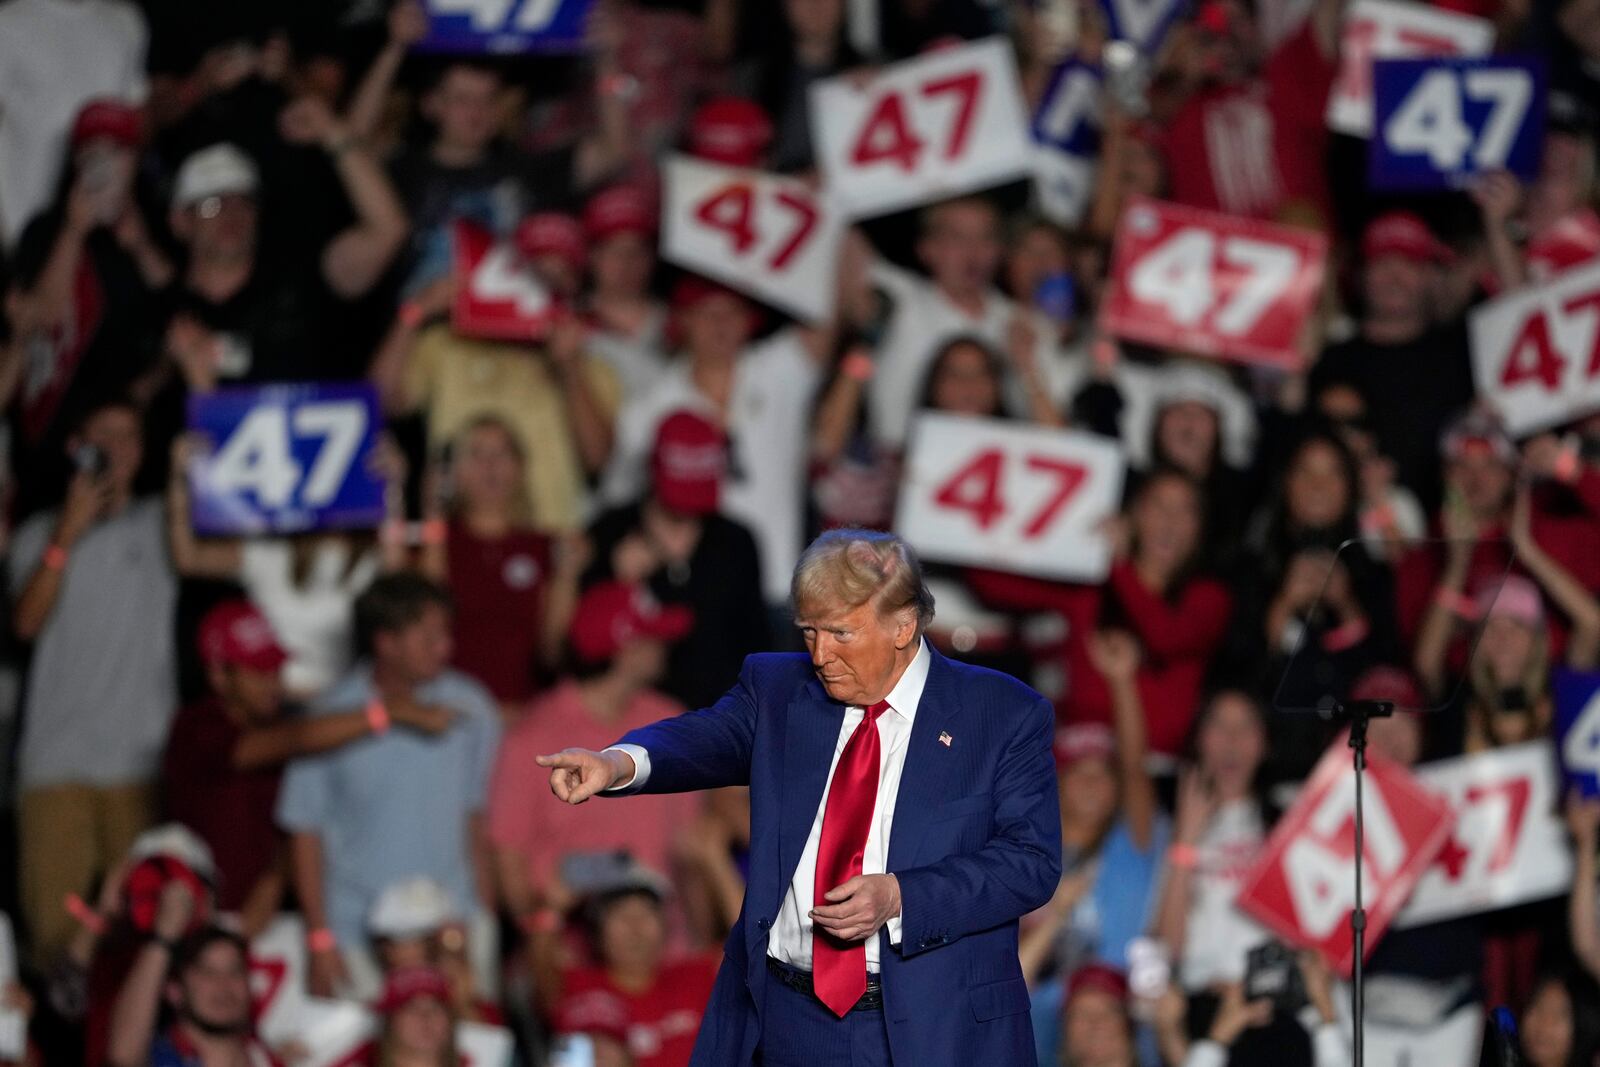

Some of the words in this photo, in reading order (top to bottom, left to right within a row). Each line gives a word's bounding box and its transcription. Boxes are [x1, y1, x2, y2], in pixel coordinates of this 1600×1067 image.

[849, 69, 984, 173] 47
[1384, 67, 1533, 168] 47
[692, 178, 821, 271] 47
[471, 243, 548, 316] 4
[1128, 227, 1298, 335] 47
[212, 402, 368, 508] 47
[933, 447, 1091, 540] 47
[1283, 767, 1407, 940] 47
